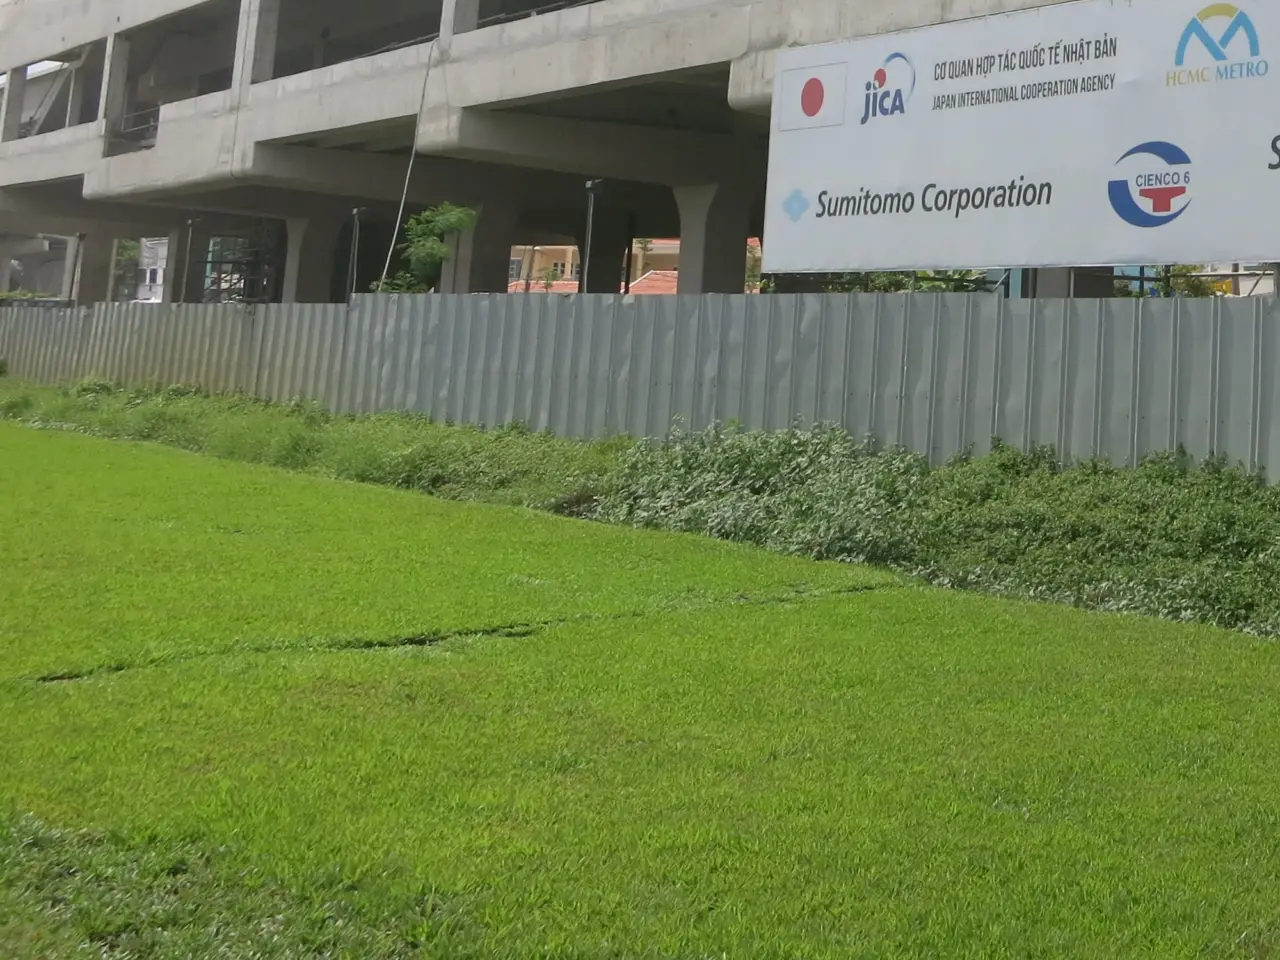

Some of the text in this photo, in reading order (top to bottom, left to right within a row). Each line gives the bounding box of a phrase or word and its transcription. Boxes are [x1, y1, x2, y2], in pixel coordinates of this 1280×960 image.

[933, 32, 1118, 81] CƠ QUAN HỢP TÁC QUỐC TẾ NHẬT BẢN
[1165, 60, 1269, 87] HCMC METRO
[932, 73, 1116, 111] JAPAN INTERNATIONAL COOPERATION AGENCY
[815, 175, 1053, 218] Sumitomo Corporation
[1135, 171, 1190, 187] CIENCO 6
